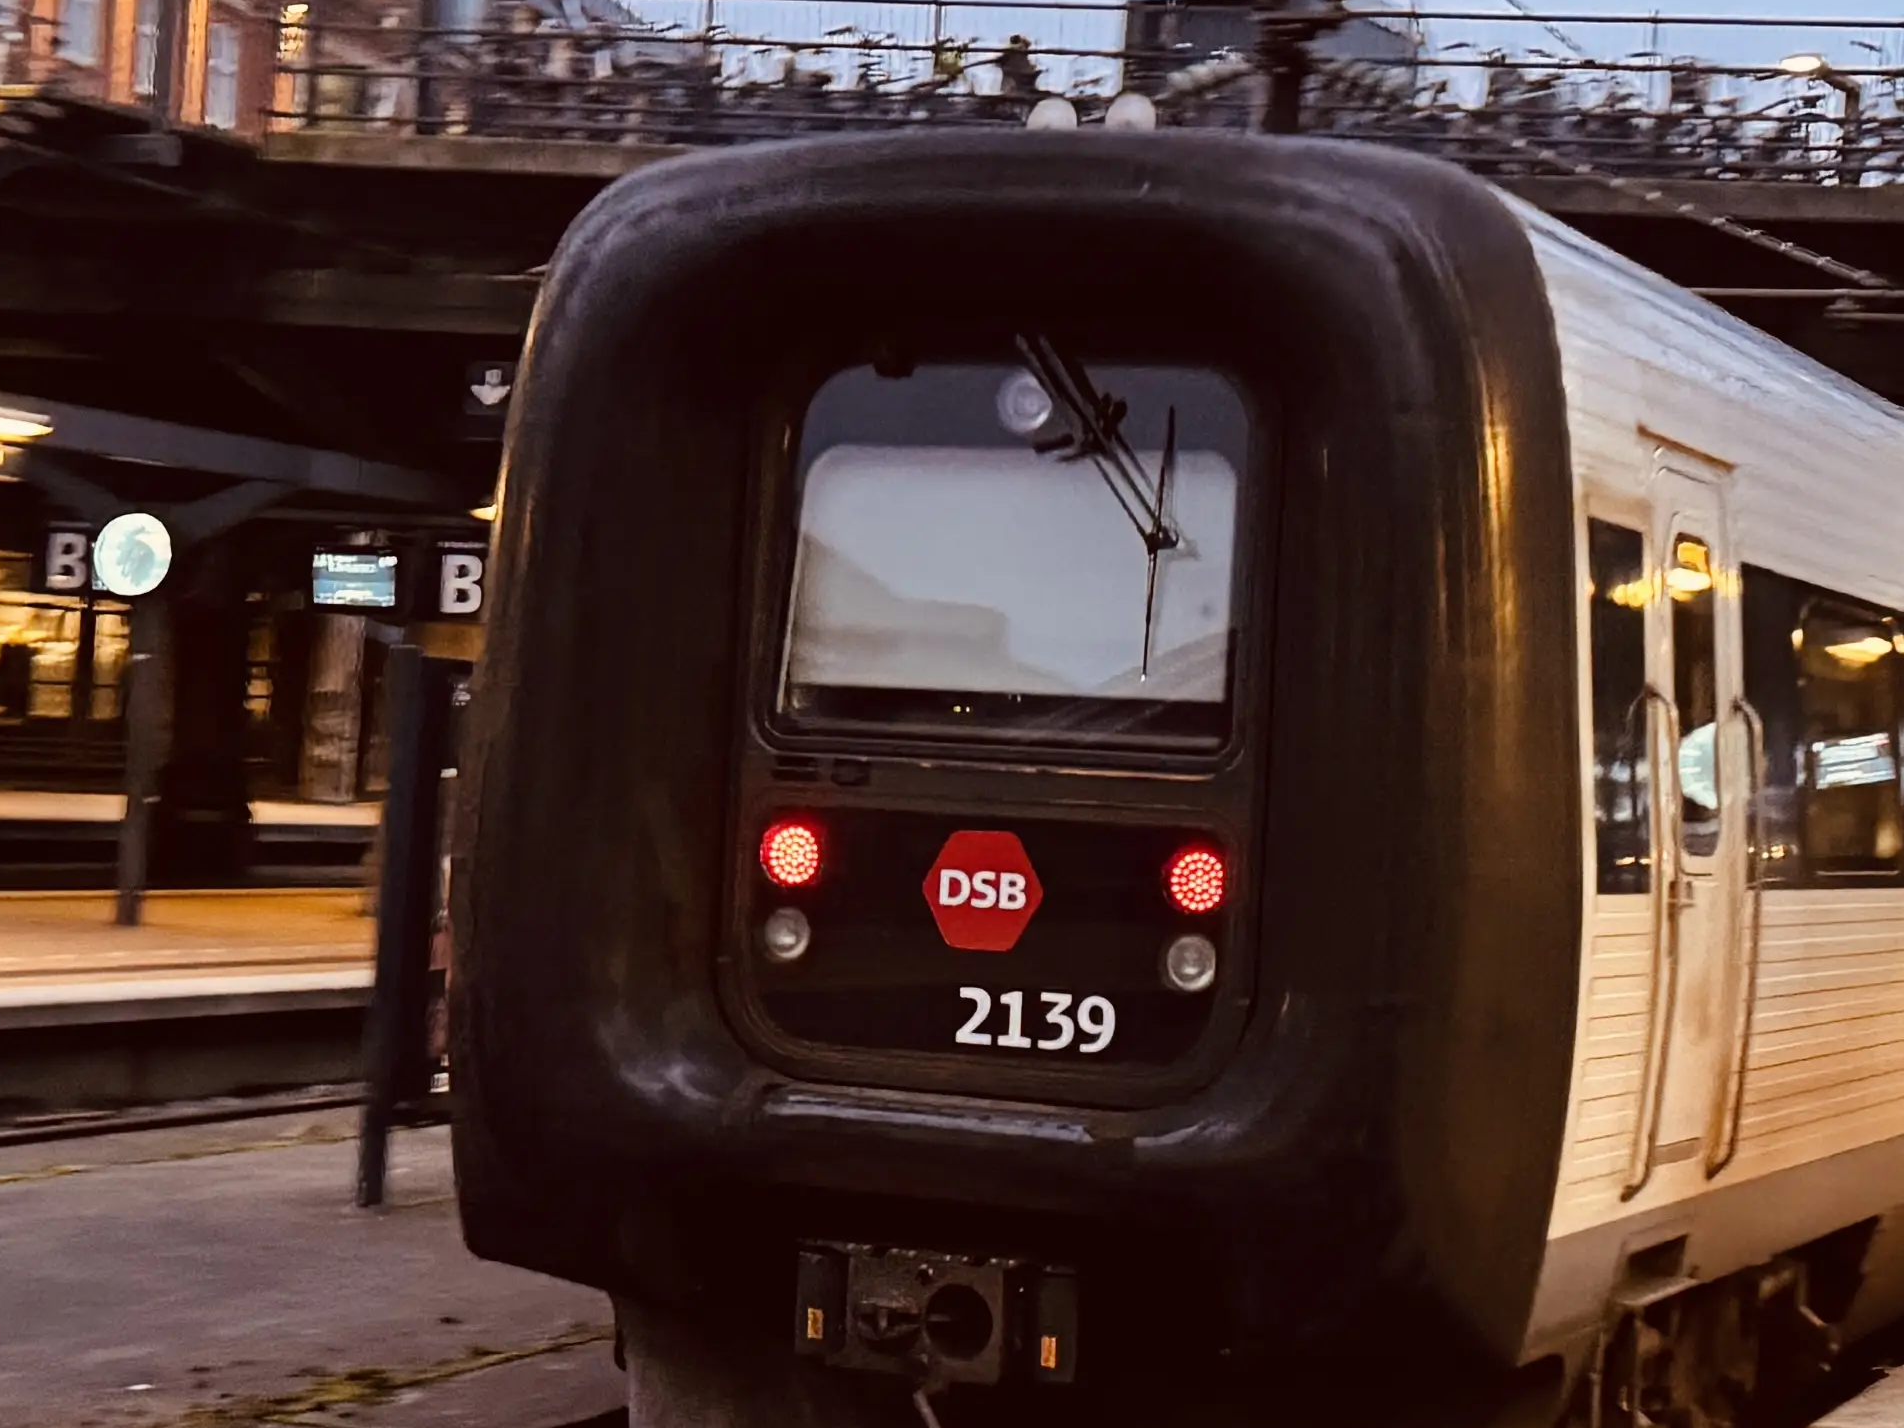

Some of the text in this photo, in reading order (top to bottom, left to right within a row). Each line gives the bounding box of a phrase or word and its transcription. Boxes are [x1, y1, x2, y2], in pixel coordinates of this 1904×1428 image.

[45, 532, 88, 589] B
[440, 554, 483, 613] B
[939, 869, 1027, 910] DSB
[955, 986, 1116, 1053] 2139
